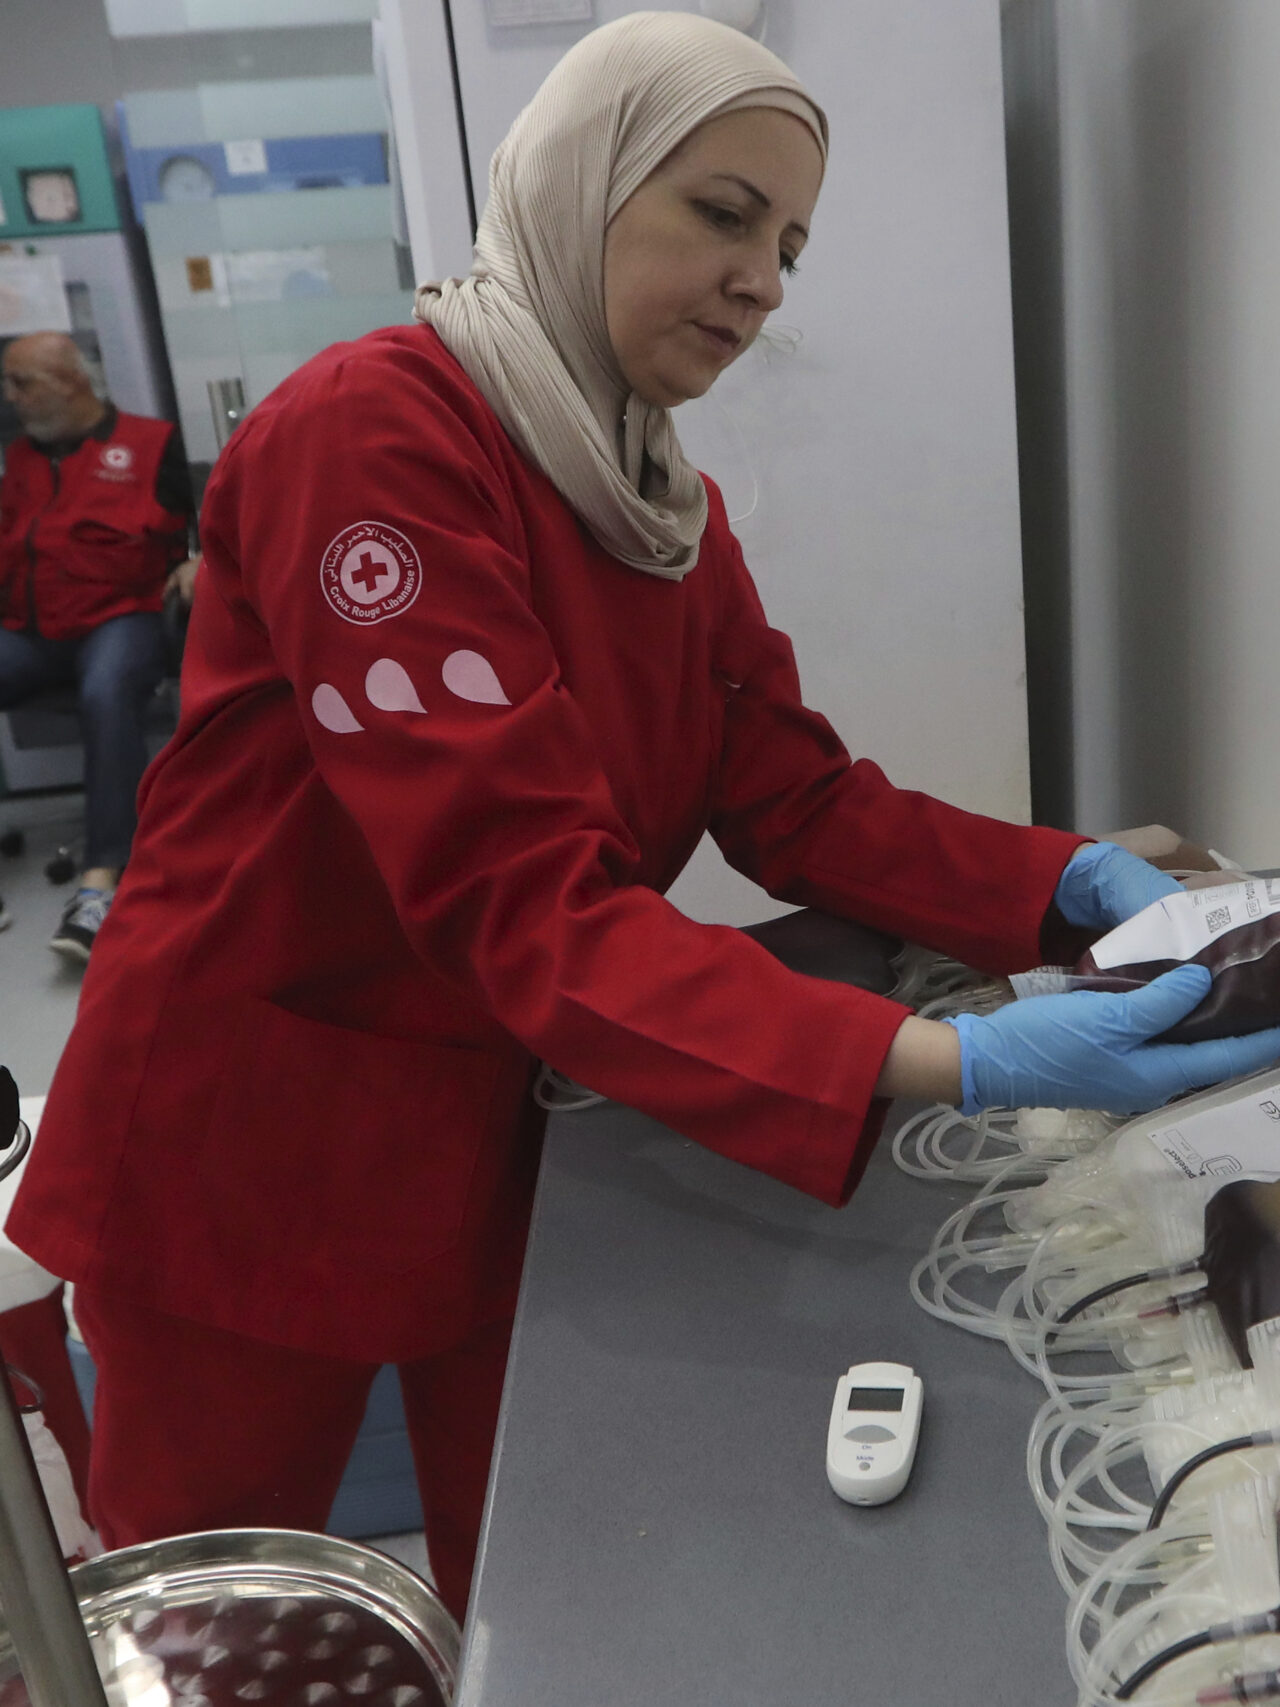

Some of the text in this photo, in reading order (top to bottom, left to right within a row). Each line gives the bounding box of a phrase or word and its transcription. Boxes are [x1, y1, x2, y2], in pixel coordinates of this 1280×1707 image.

[324, 543, 344, 582] اللبناني
[381, 533, 414, 567] الصليب
[330, 570, 415, 619] Croix Rouge Libanaise
